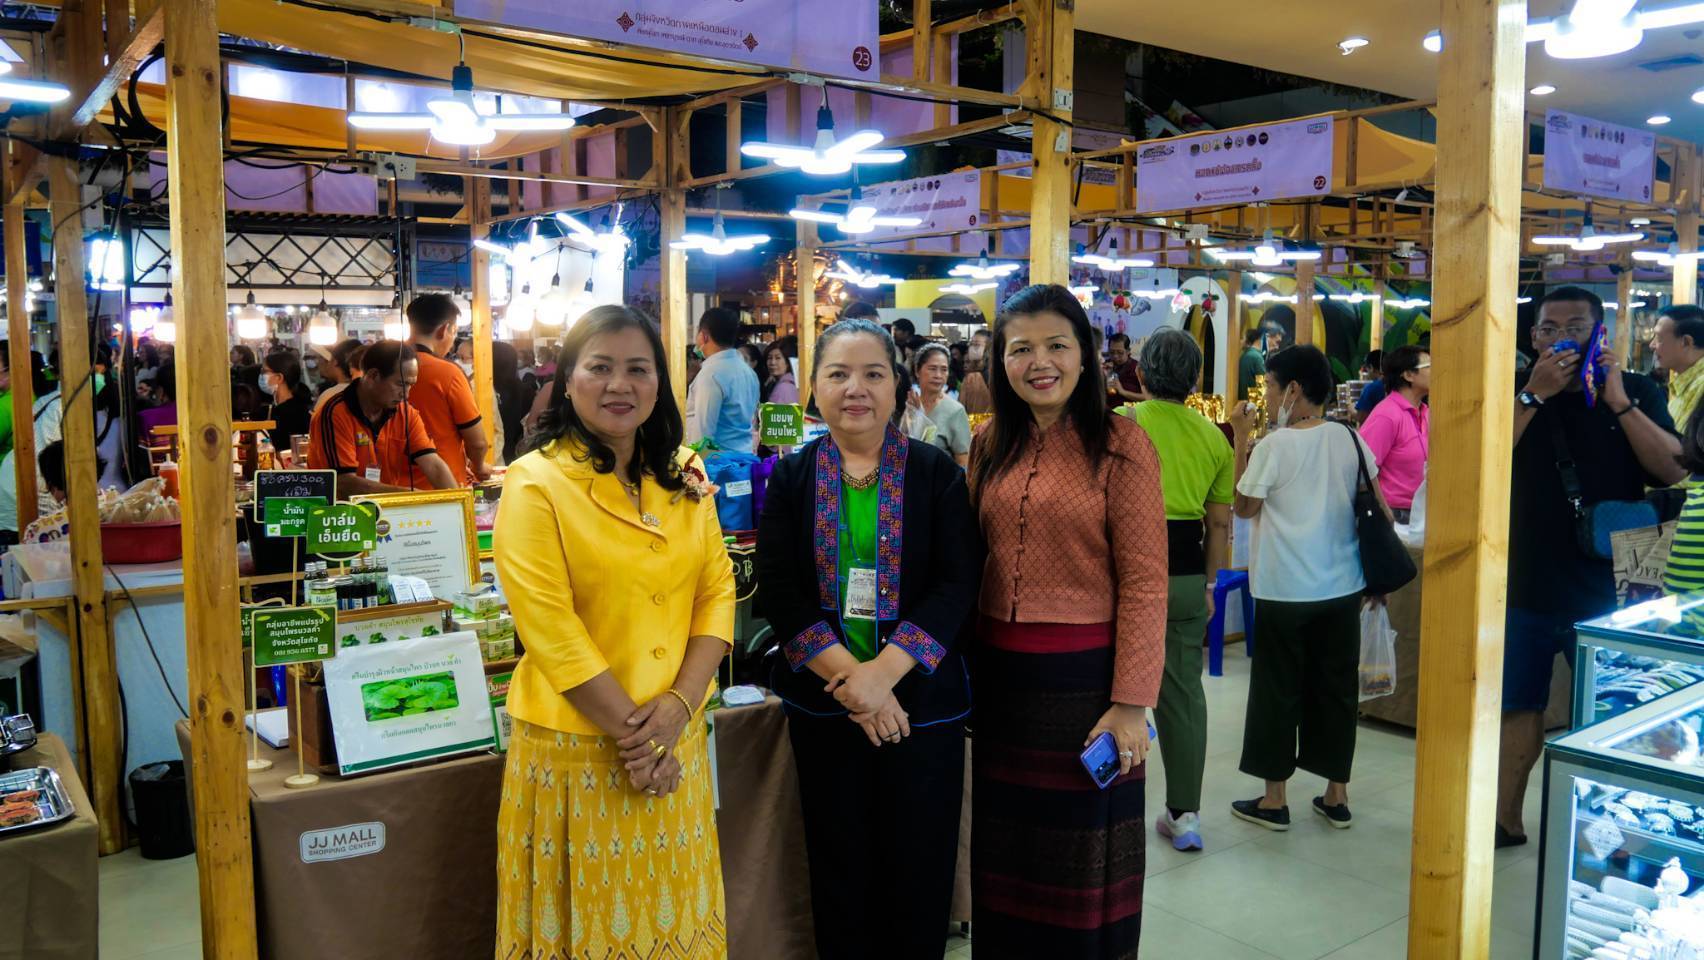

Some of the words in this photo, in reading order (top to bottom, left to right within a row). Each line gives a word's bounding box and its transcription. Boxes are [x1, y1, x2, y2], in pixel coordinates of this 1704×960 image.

[856, 51, 870, 67] 23
[1315, 177, 1326, 188] 22
[770, 413, 794, 426] แชมพู
[767, 425, 797, 439] สมุนไพร
[283, 503, 305, 515] น้ำมัน
[280, 518, 306, 528] มะกรูด
[322, 512, 356, 527] บาล์ม
[318, 528, 361, 543] เอ็นยืด
[266, 617, 324, 630] กลุ่มอาชีพแปรรูป
[271, 636, 319, 648] จังหวัดสุโขทัย
[308, 835, 328, 850] JJ
[333, 828, 377, 847] MALL
[308, 846, 346, 856] SHOPPING
[348, 840, 377, 851] CENTER
